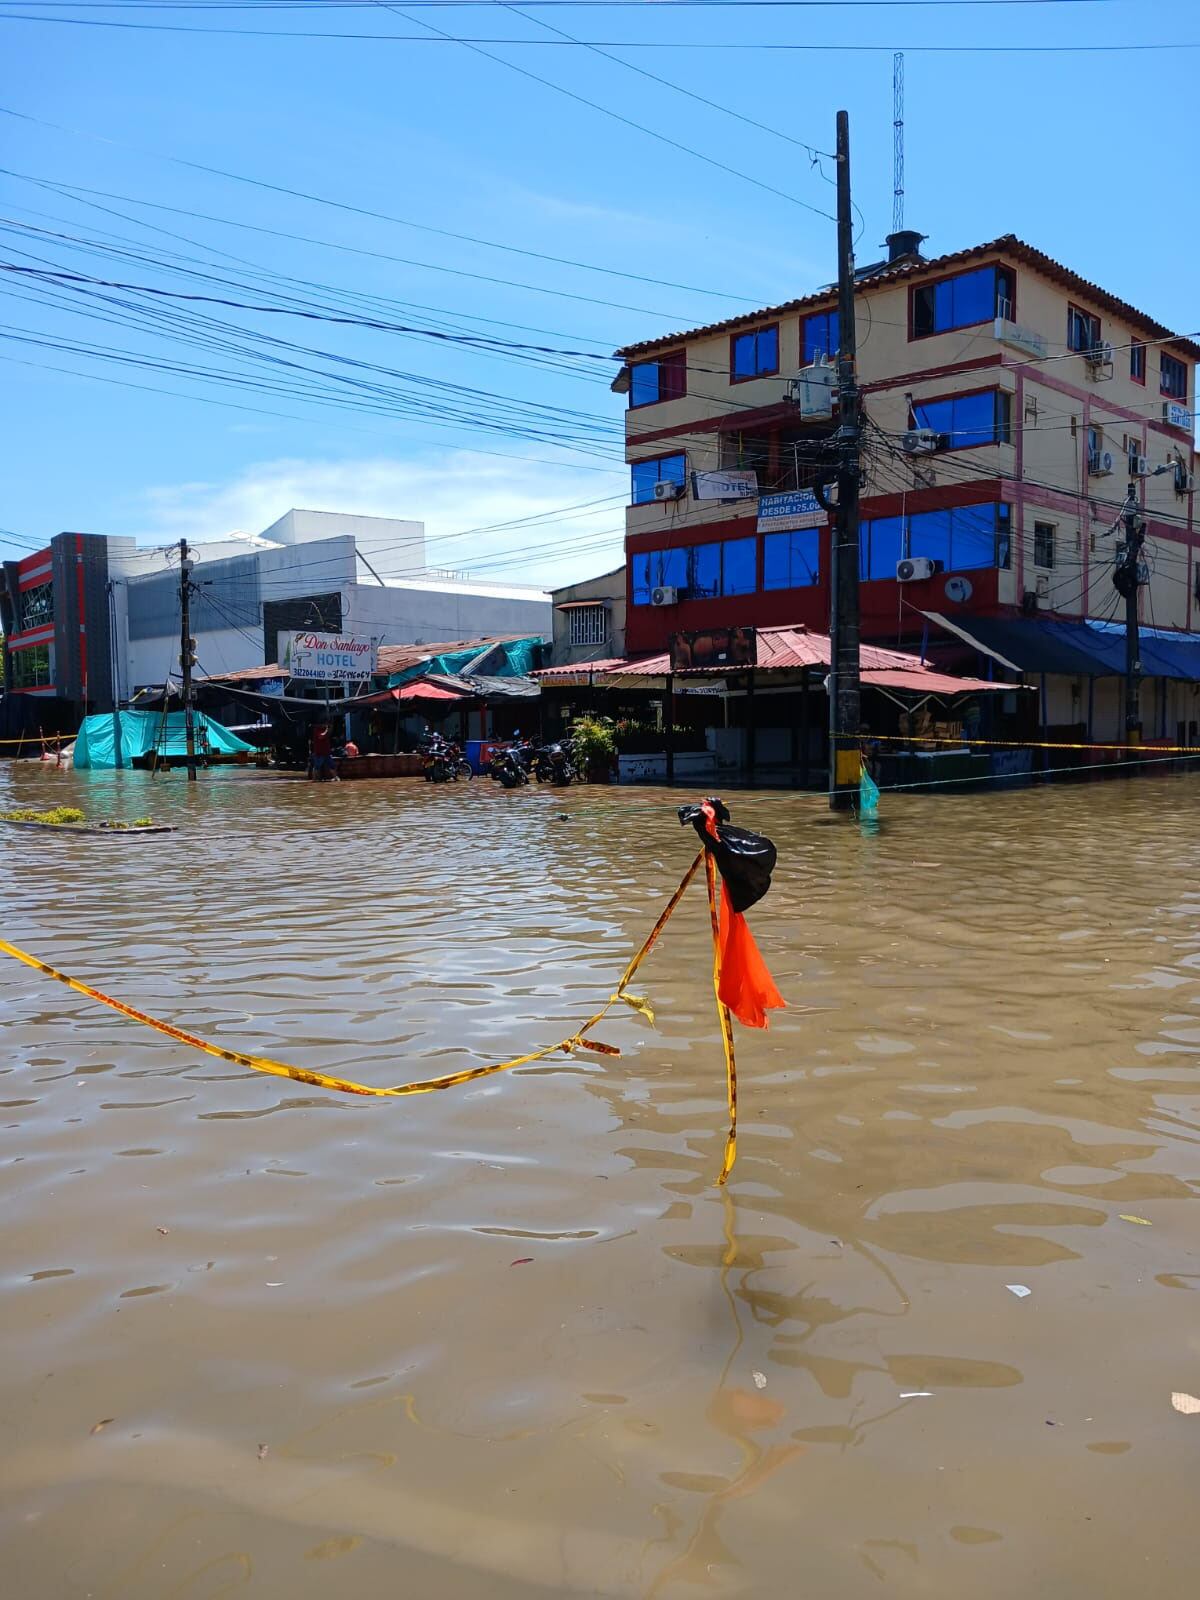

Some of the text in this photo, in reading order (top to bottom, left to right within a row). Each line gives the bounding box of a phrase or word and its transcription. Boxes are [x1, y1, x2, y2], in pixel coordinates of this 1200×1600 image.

[761, 491, 828, 506] HABITACIONS
[761, 505, 791, 516] DESDE
[304, 633, 370, 656] Don Santiago
[317, 653, 356, 667] HOTEL
